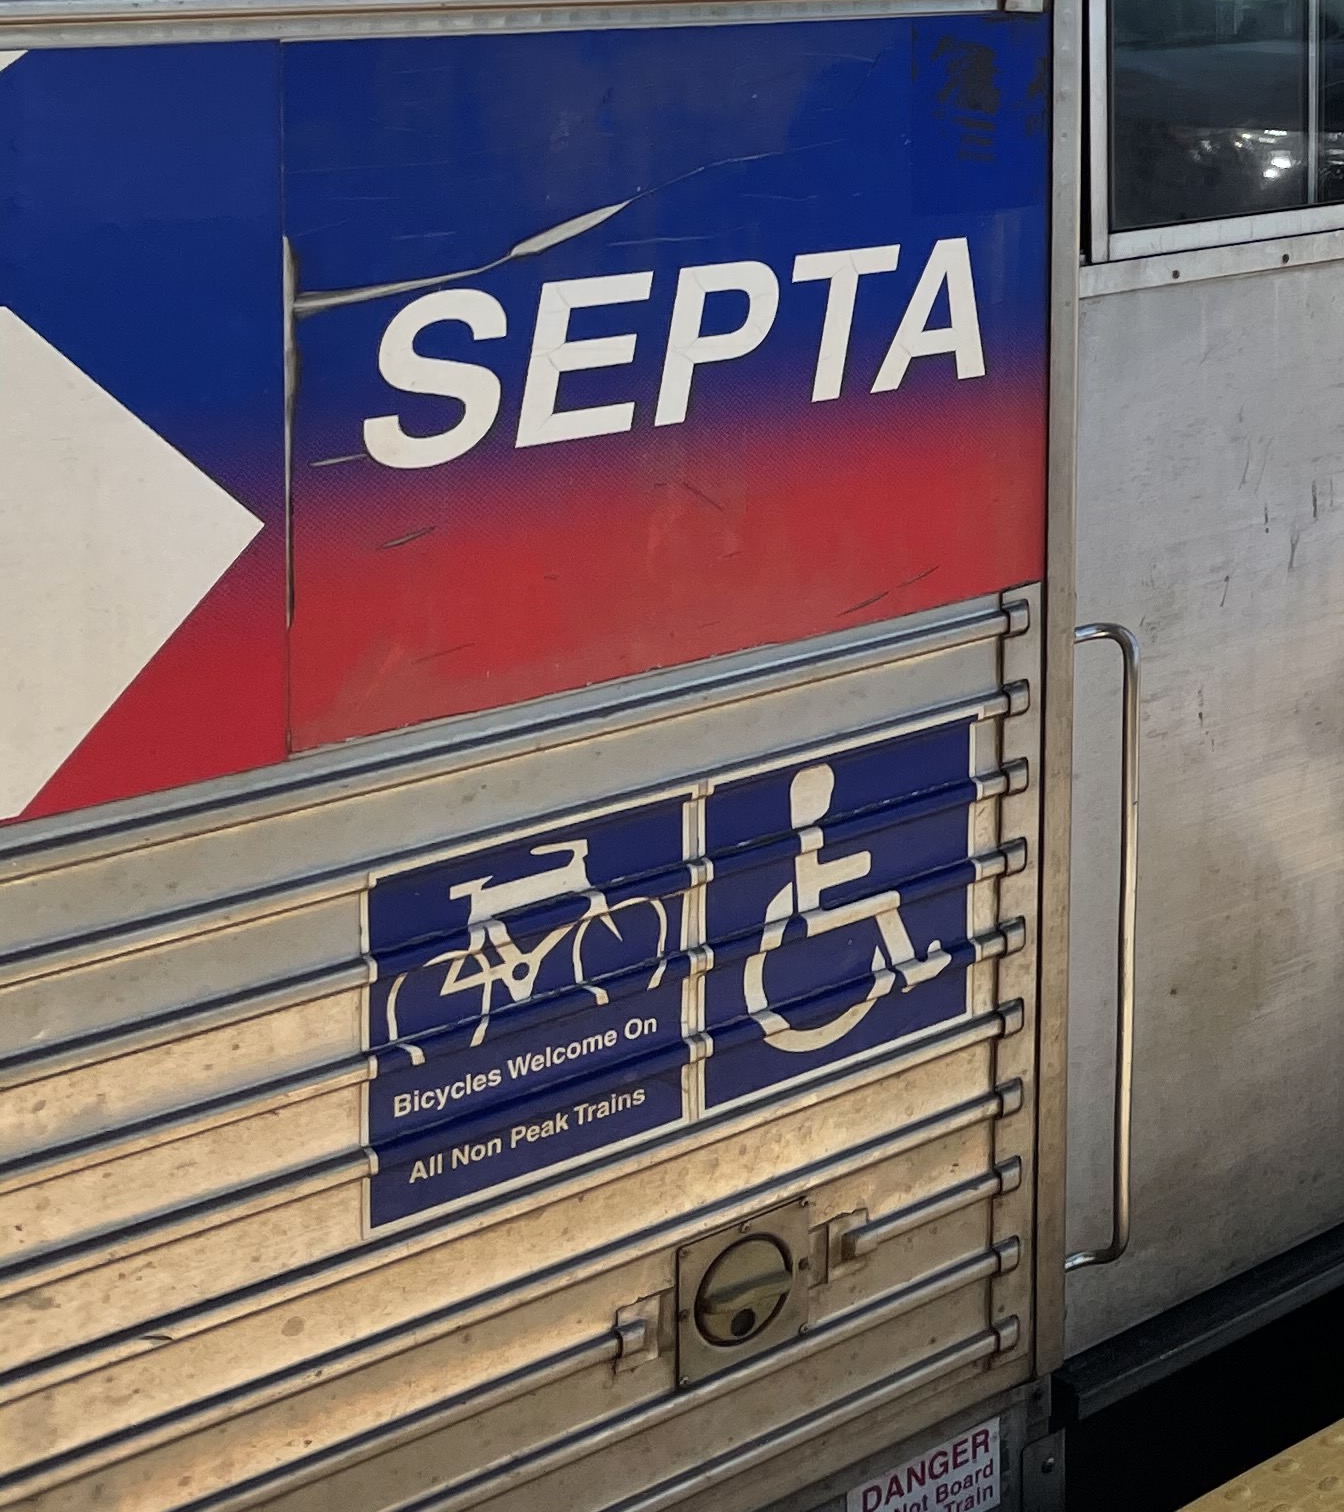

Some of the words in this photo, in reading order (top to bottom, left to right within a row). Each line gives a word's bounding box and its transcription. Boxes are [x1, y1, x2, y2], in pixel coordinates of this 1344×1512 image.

[362, 236, 986, 469] SEPTA
[393, 1067, 502, 1118] Bicycles
[507, 1026, 618, 1080] Welcome
[624, 1016, 658, 1040] On
[409, 1152, 443, 1185] All
[450, 1136, 503, 1170] Non
[510, 1112, 570, 1150] Peak
[573, 1087, 647, 1127] Trains
[862, 1428, 990, 1512] DANGER
[935, 1457, 994, 1505] Board
